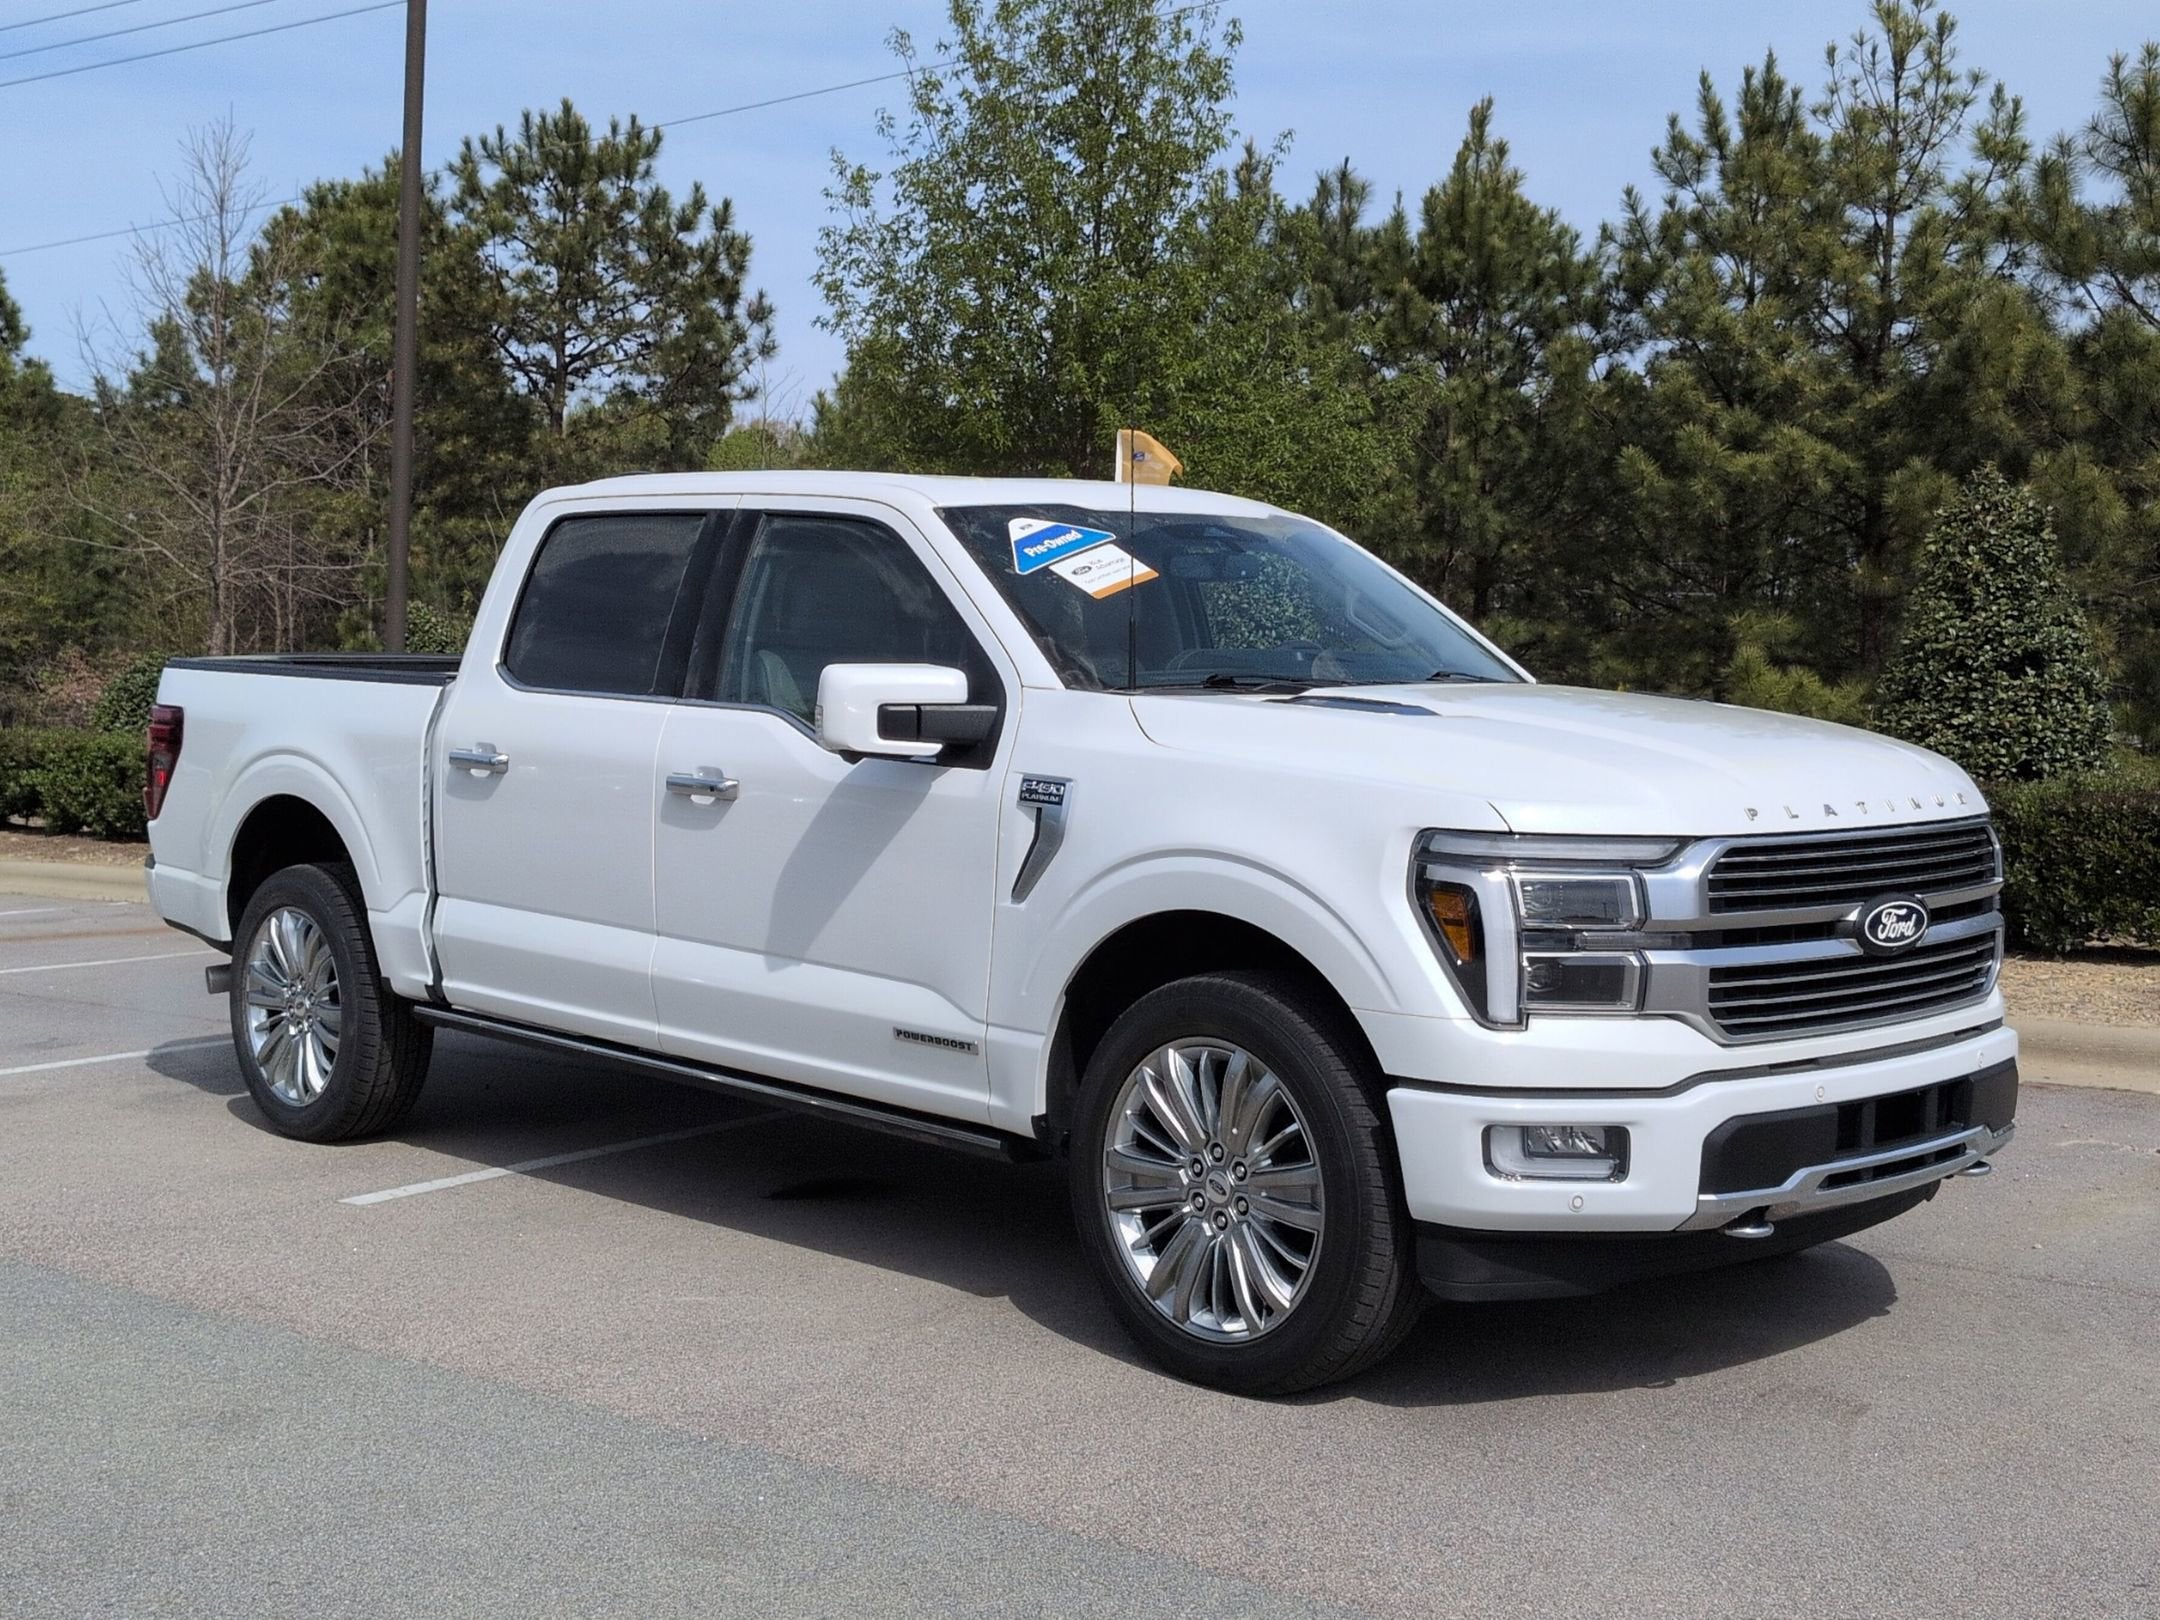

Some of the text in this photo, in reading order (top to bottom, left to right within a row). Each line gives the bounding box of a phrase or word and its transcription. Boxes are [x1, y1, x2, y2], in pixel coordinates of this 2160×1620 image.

[1023, 530, 1083, 557] Pre-Owned
[1021, 792, 1060, 802] PLATINUM
[1876, 907, 1917, 941] Ford
[895, 1028, 973, 1051] POWERBOOST
